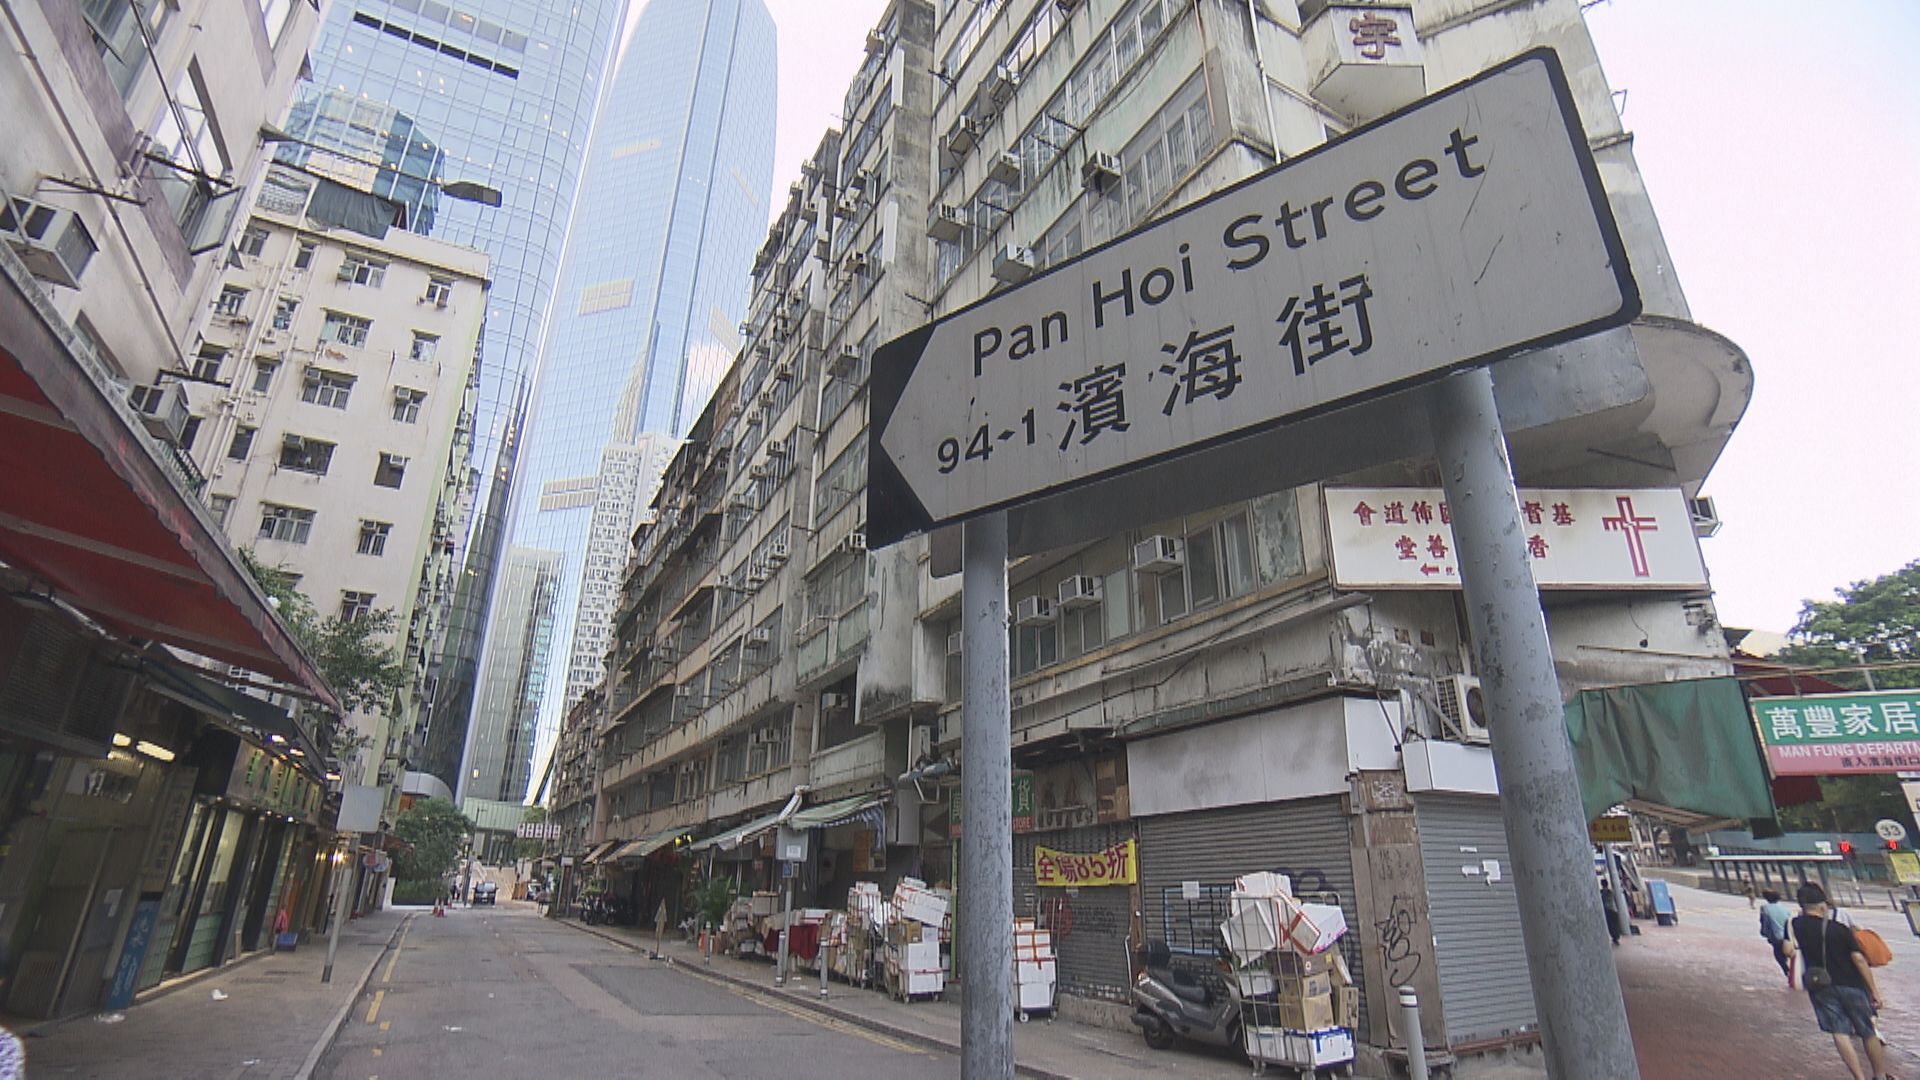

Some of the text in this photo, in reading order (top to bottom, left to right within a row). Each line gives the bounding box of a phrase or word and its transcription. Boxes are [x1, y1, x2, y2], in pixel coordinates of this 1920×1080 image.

[1350, 11, 1402, 60] 宇
[973, 127, 1486, 378] Pan Hoi Street
[937, 273, 1374, 474] 94-1 濱海街
[1765, 702, 1920, 740] 萬豐家居
[1779, 745, 1811, 758] MAN
[1813, 743, 1854, 757] FUNG
